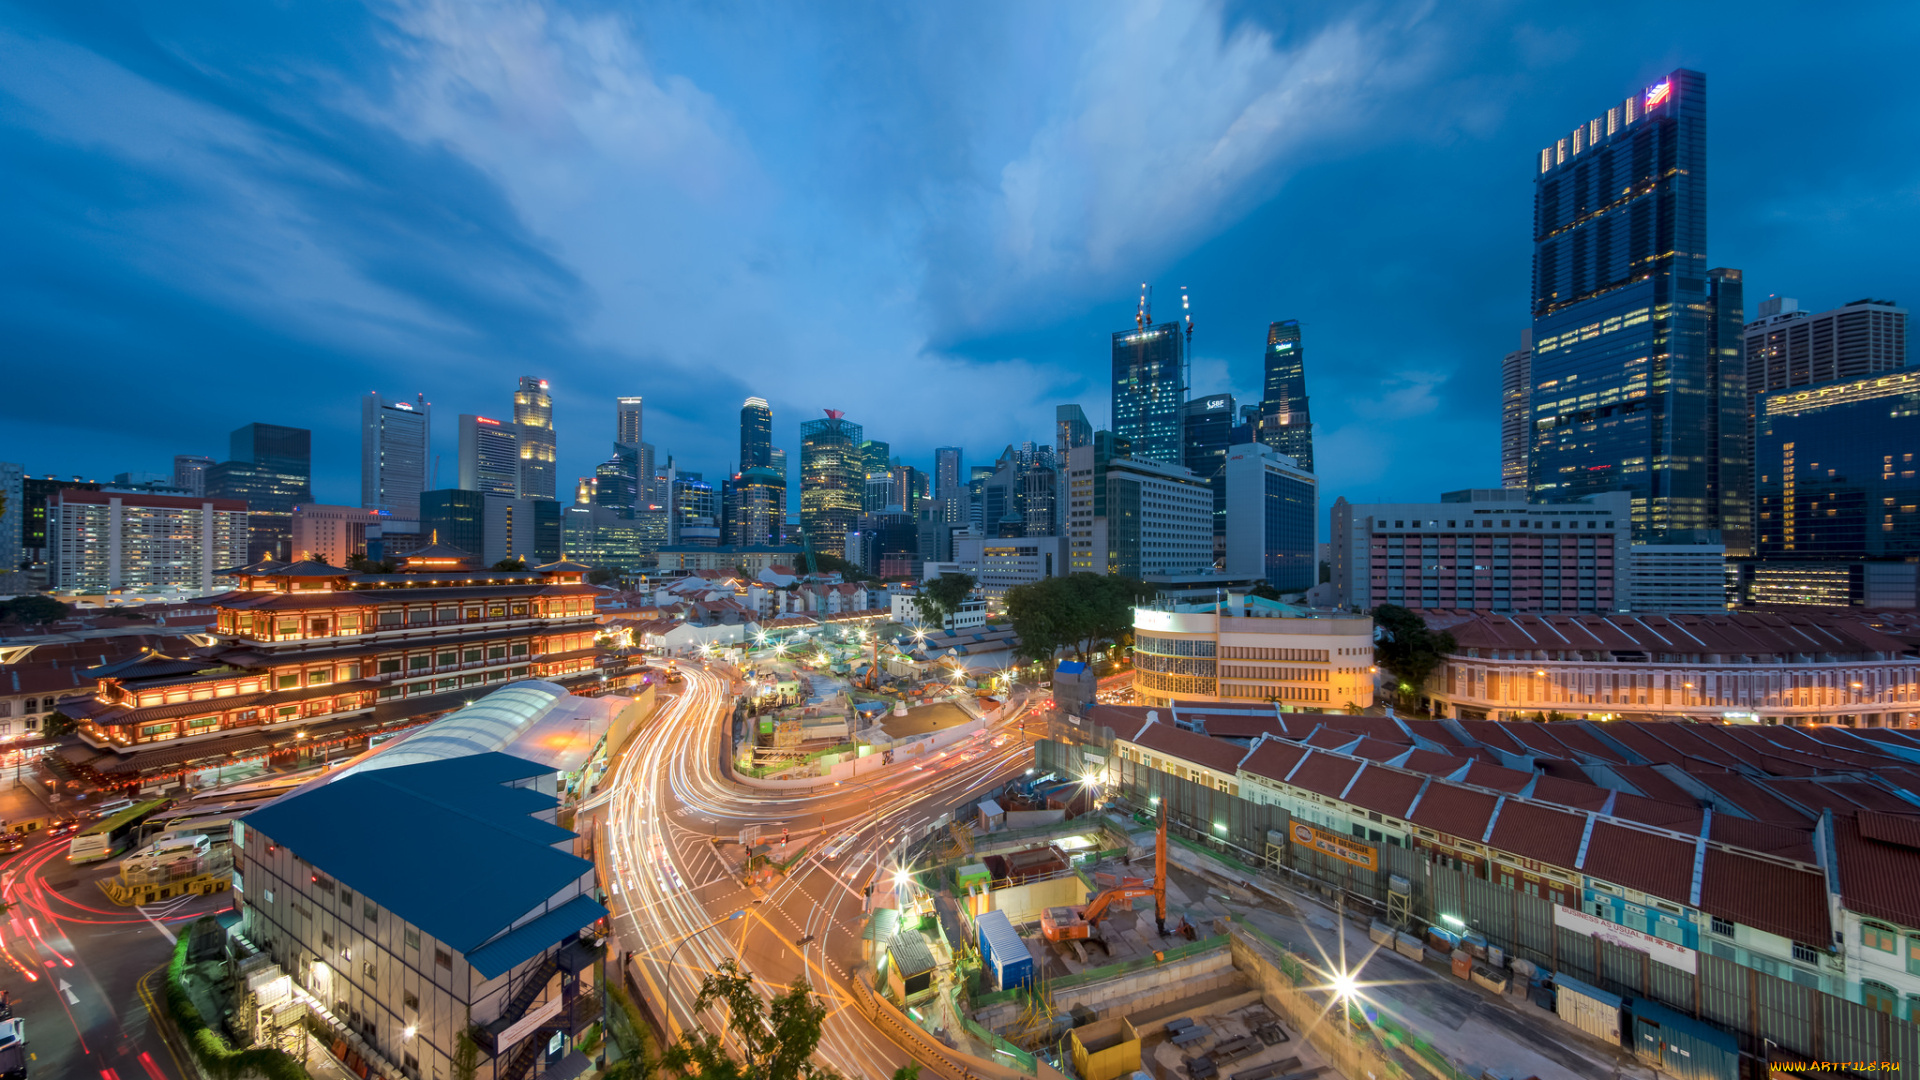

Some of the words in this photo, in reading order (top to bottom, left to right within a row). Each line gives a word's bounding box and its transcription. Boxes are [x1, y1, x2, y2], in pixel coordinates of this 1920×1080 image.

[1776, 375, 1915, 404] SOFITEL
[1315, 830, 1336, 844] FIGHT
[1561, 906, 1600, 924] BUSINESS
[1601, 920, 1612, 930] AS
[1613, 923, 1641, 938] USUAL
